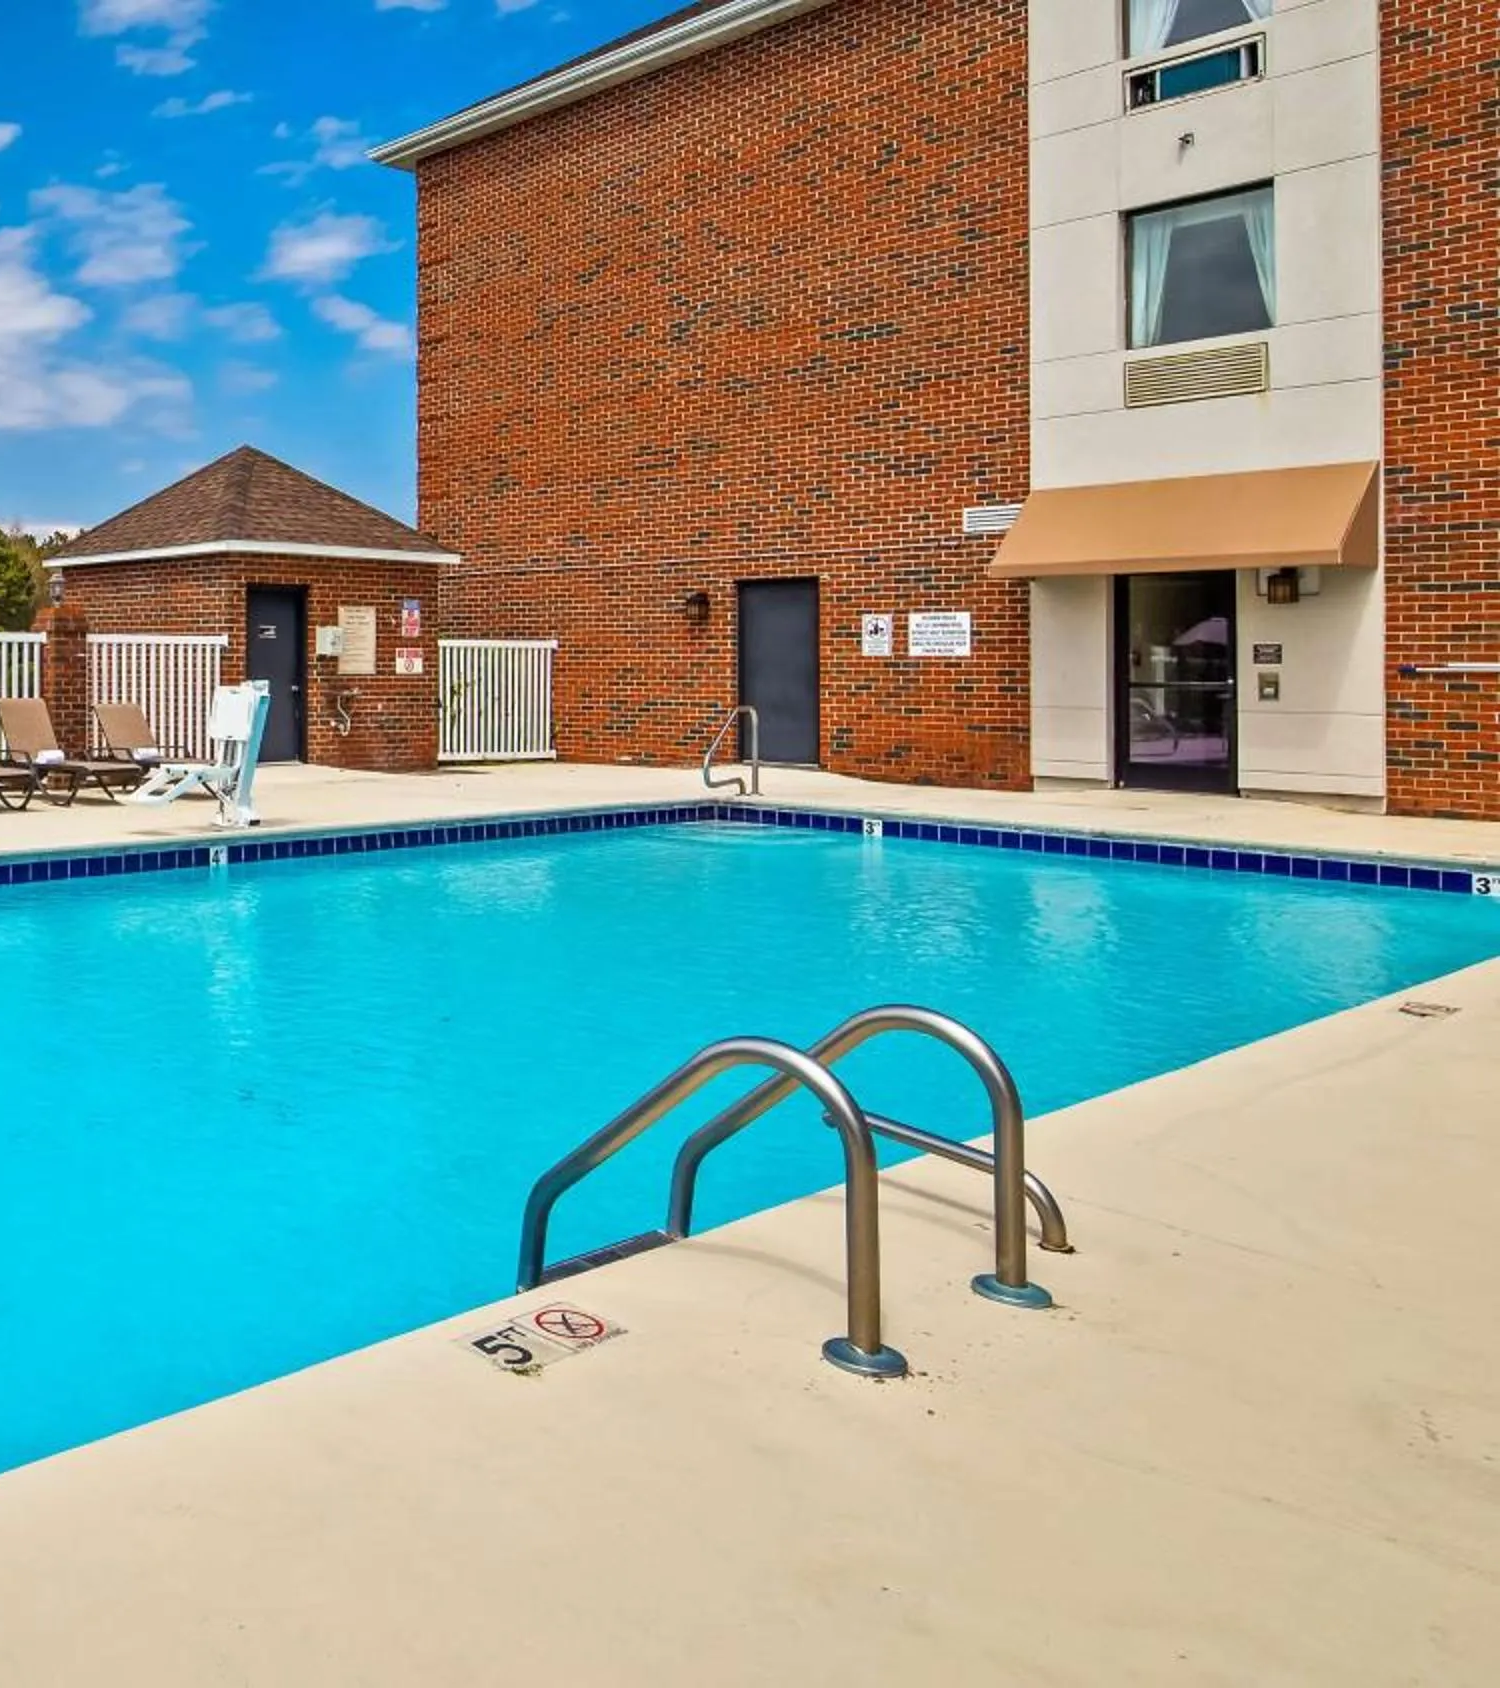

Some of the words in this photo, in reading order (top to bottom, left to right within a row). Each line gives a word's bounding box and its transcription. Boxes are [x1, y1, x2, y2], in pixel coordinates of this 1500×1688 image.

[1475, 877, 1491, 895] 3
[496, 1326, 526, 1342] FT
[471, 1335, 533, 1365] 5
